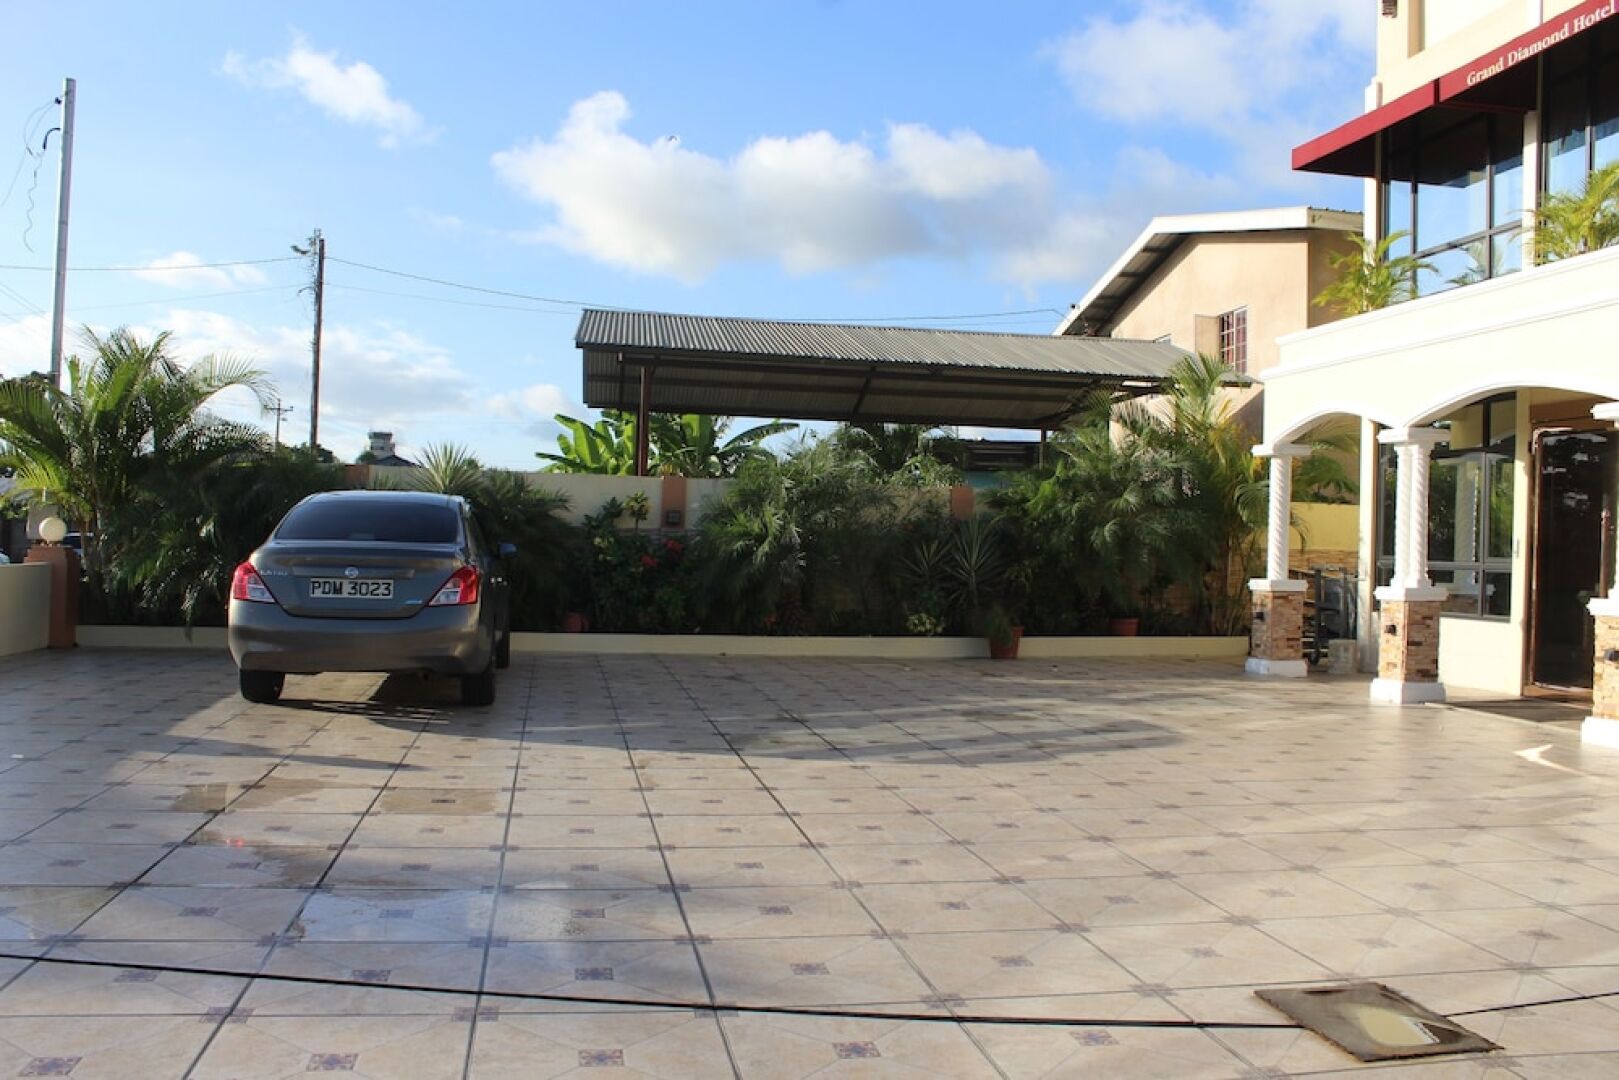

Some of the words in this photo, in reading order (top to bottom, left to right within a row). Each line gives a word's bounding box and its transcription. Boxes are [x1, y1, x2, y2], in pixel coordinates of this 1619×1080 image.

[1466, 57, 1504, 86] Grand
[1508, 22, 1569, 67] Diamond
[1573, 0, 1615, 32] Hotel
[347, 581, 391, 597] 3023
